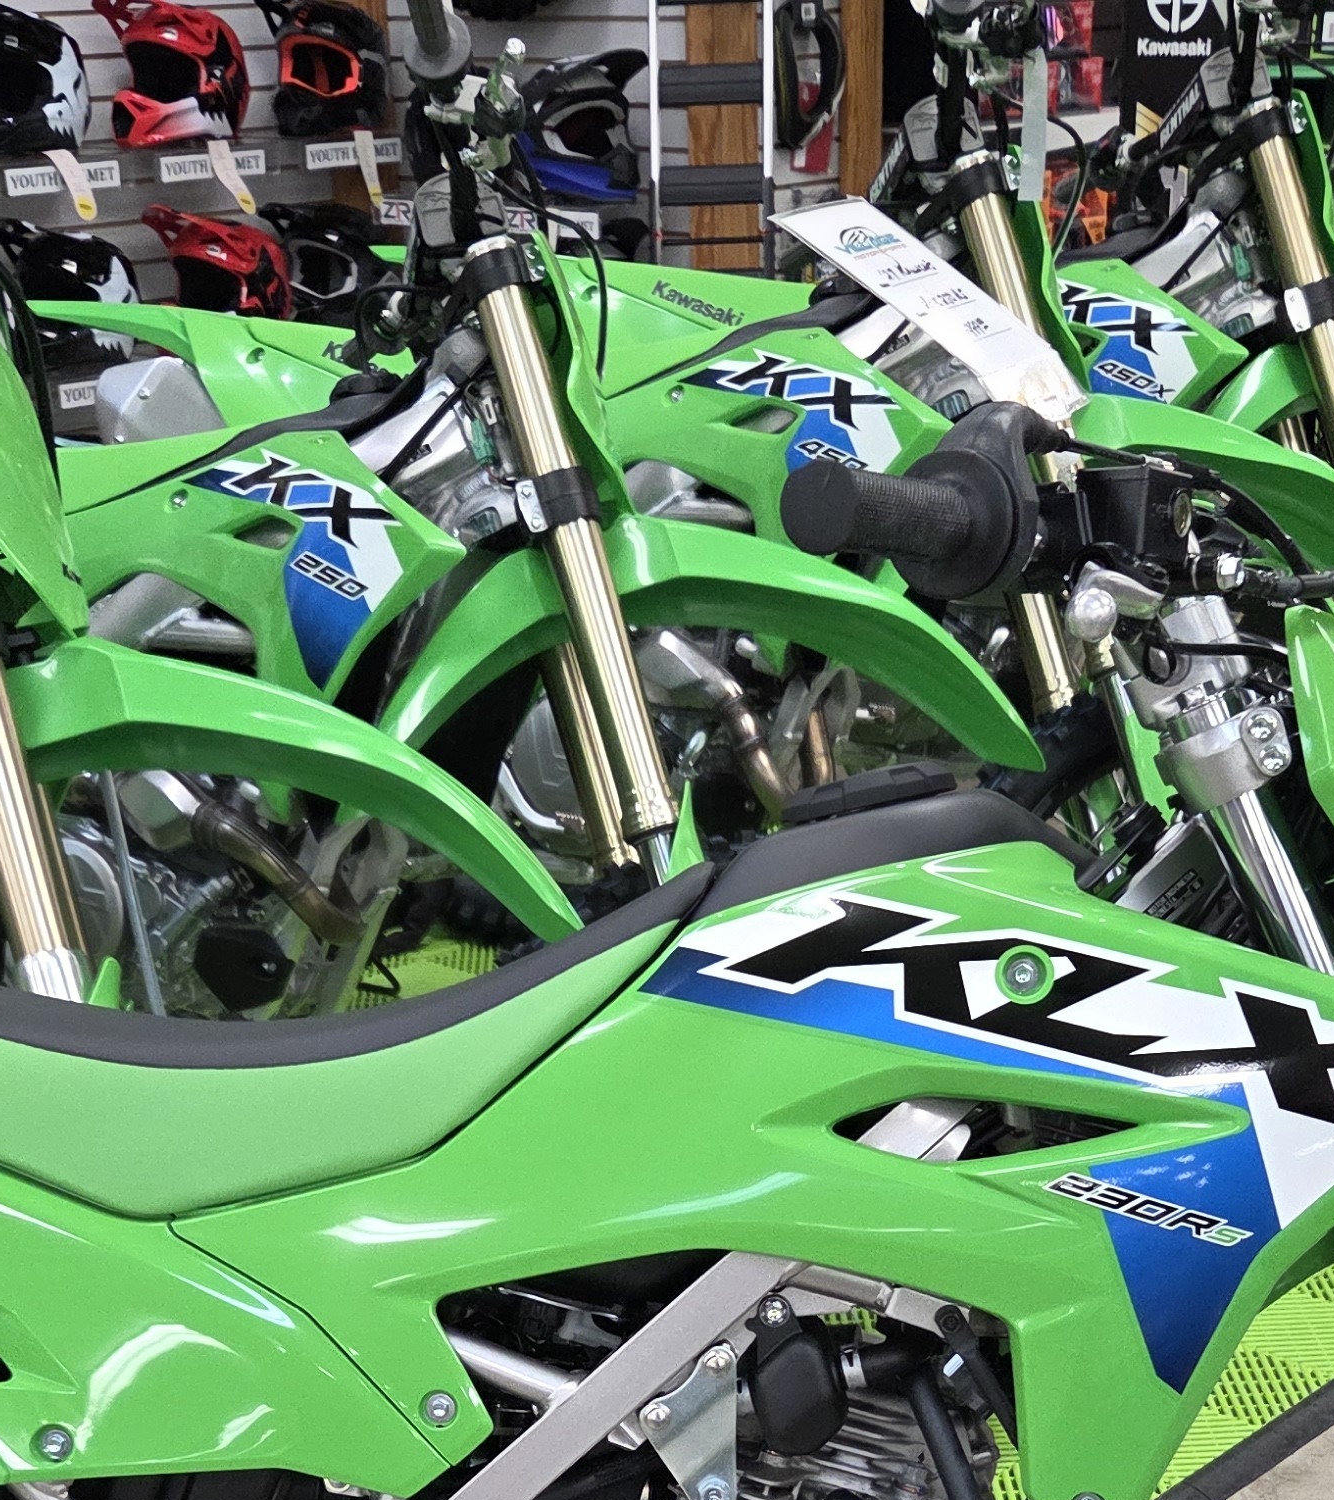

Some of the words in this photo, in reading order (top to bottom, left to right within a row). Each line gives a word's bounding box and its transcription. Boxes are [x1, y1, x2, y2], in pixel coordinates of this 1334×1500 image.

[1136, 37, 1213, 57] Kawasaki
[165, 159, 209, 176] YOUTH
[310, 145, 350, 163] YOUTH
[10, 170, 58, 189] YOUTH
[651, 279, 746, 327] Kawasaki
[1061, 284, 1194, 355] KX
[63, 385, 93, 403] YOU
[724, 354, 899, 431] KX
[1095, 360, 1177, 398] 450X
[229, 456, 398, 549] KX
[291, 553, 369, 599] 250
